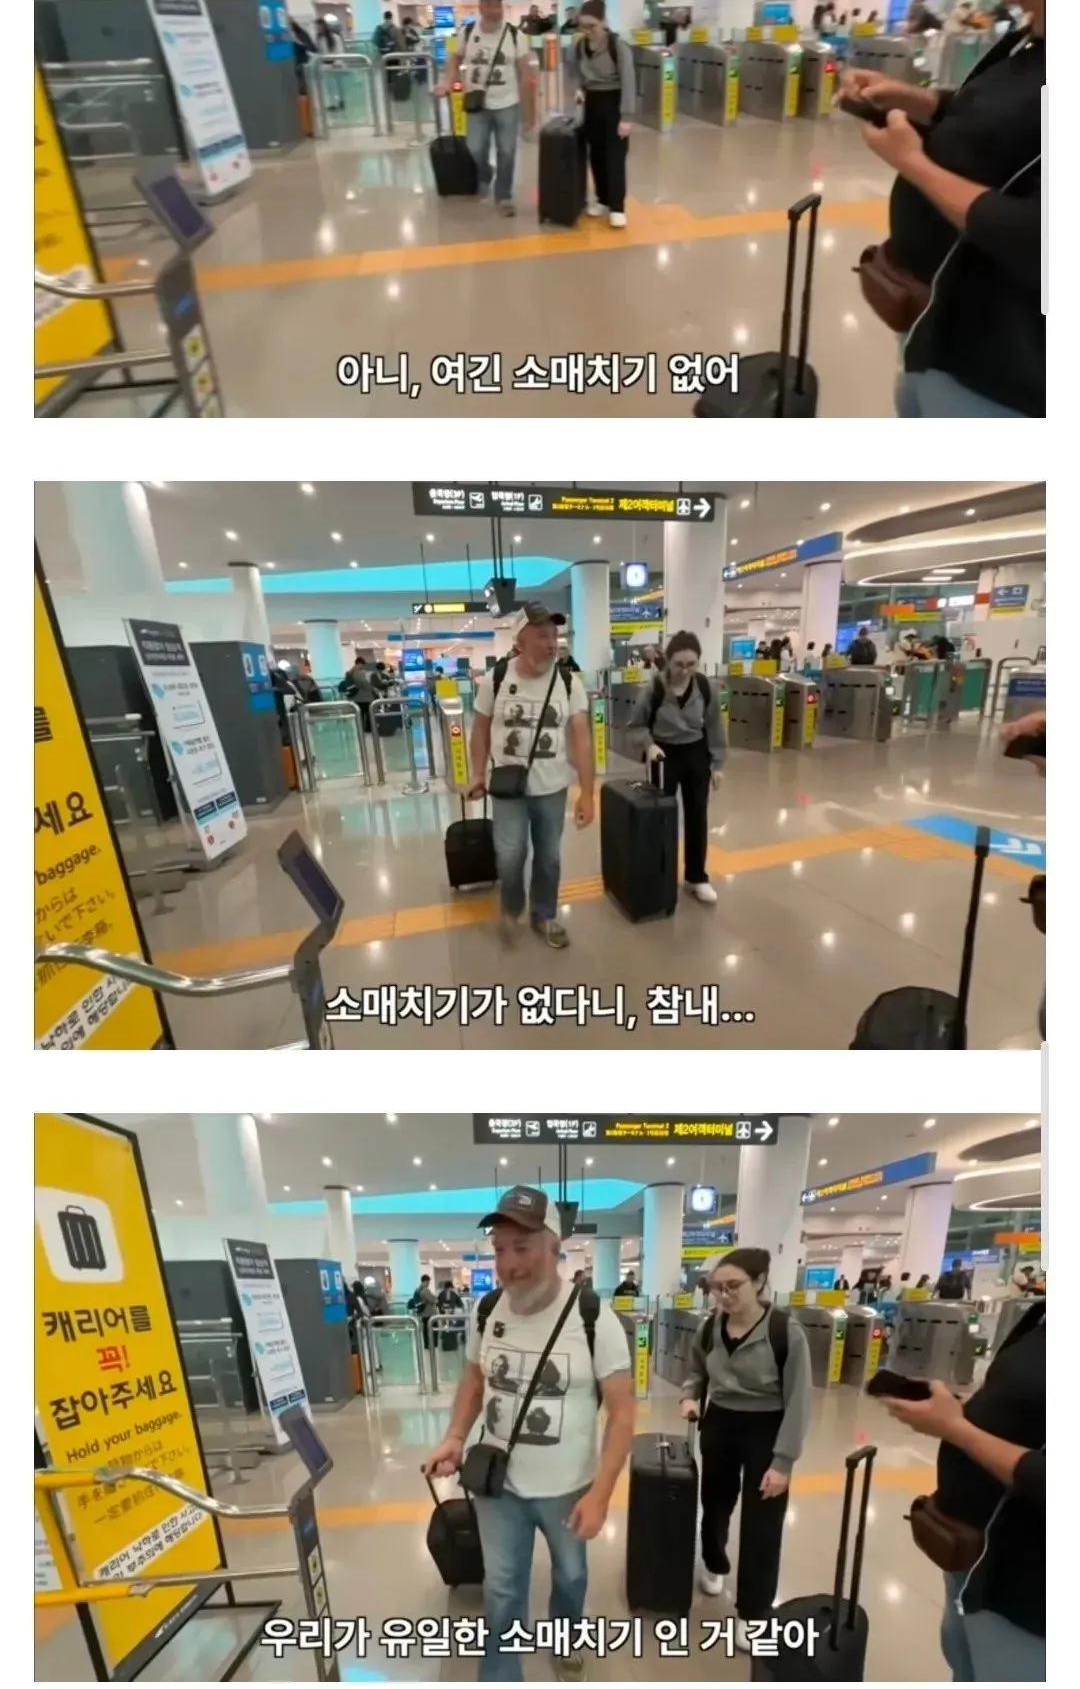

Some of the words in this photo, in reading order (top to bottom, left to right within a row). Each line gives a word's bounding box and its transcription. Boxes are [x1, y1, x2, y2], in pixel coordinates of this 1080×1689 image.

[41, 1305, 152, 1343] 캐리어를
[96, 1345, 130, 1373] 꼭!
[49, 1369, 178, 1431] 잡아주세요
[66, 1438, 101, 1463] Hold
[103, 1429, 133, 1452] your
